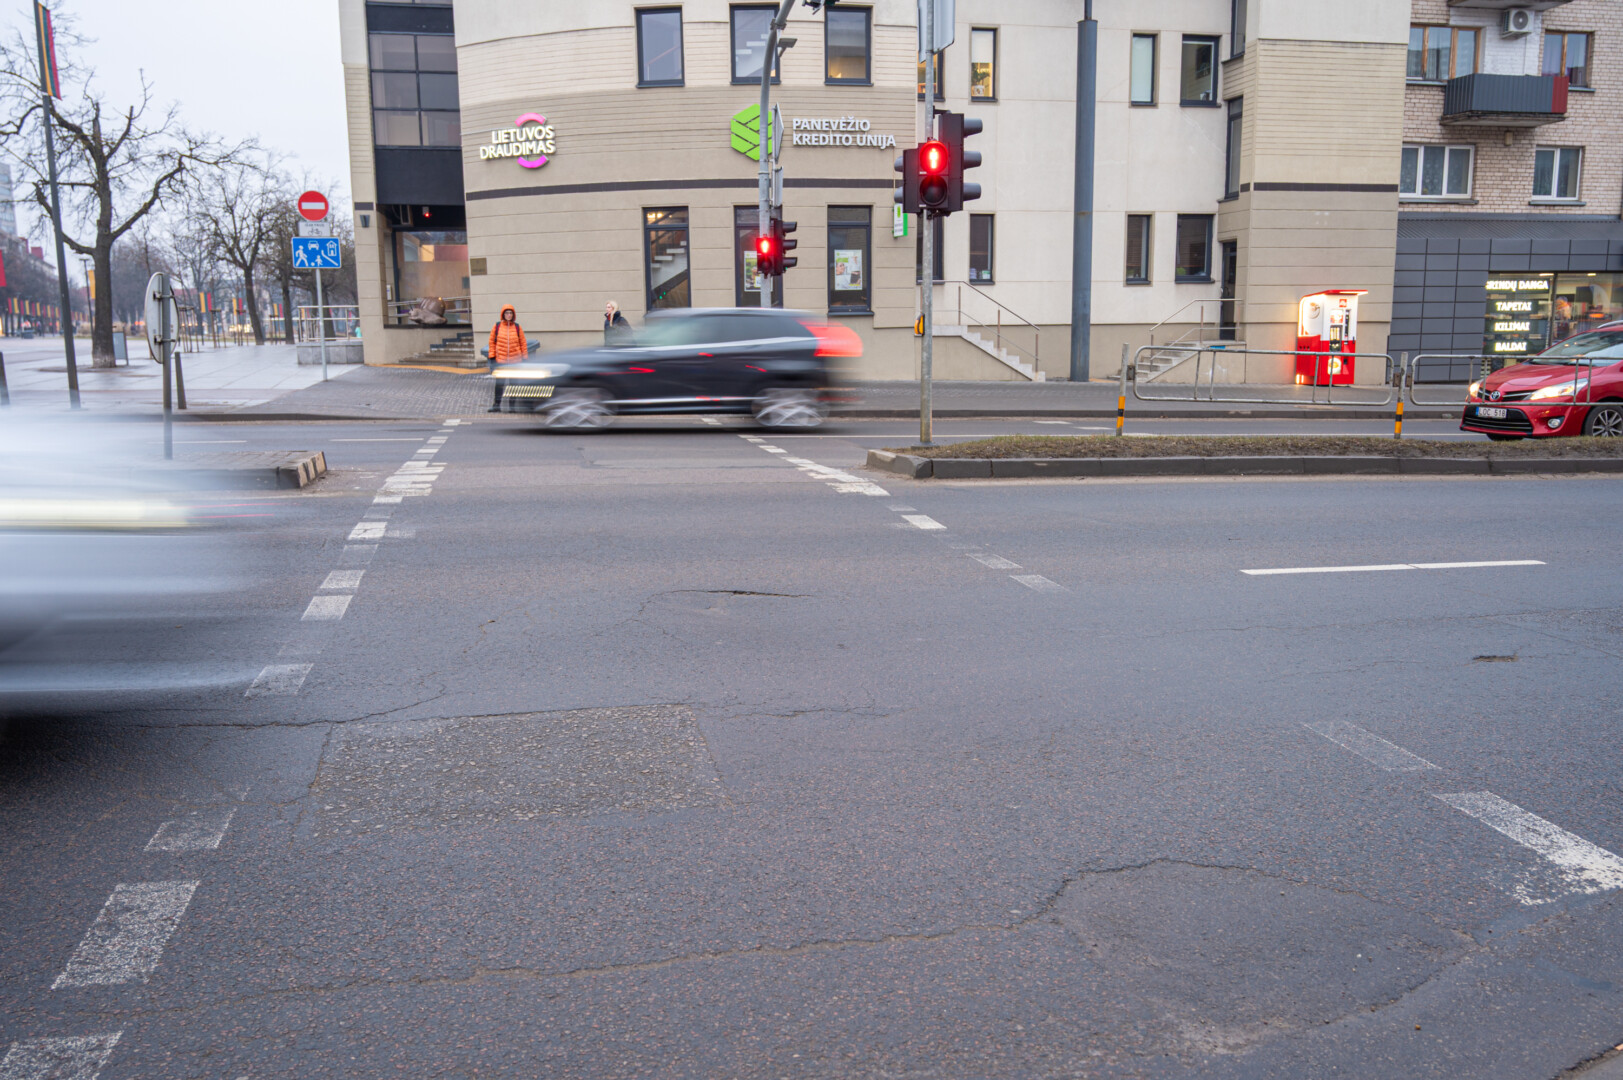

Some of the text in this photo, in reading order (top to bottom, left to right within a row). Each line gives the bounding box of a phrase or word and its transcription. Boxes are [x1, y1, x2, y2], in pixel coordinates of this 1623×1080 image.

[792, 116, 871, 131] PANEVĖŽIO
[491, 125, 556, 144] LIETUVOS
[792, 133, 897, 149] KREDITO UNIJA
[479, 139, 557, 160] DRAUDIMAS
[1518, 280, 1549, 290] DANGA
[1495, 301, 1532, 312] TAPETAI
[1494, 321, 1531, 332] KILIMAI
[1494, 341, 1528, 352] BALDAI
[1478, 408, 1506, 418] LOC 518
